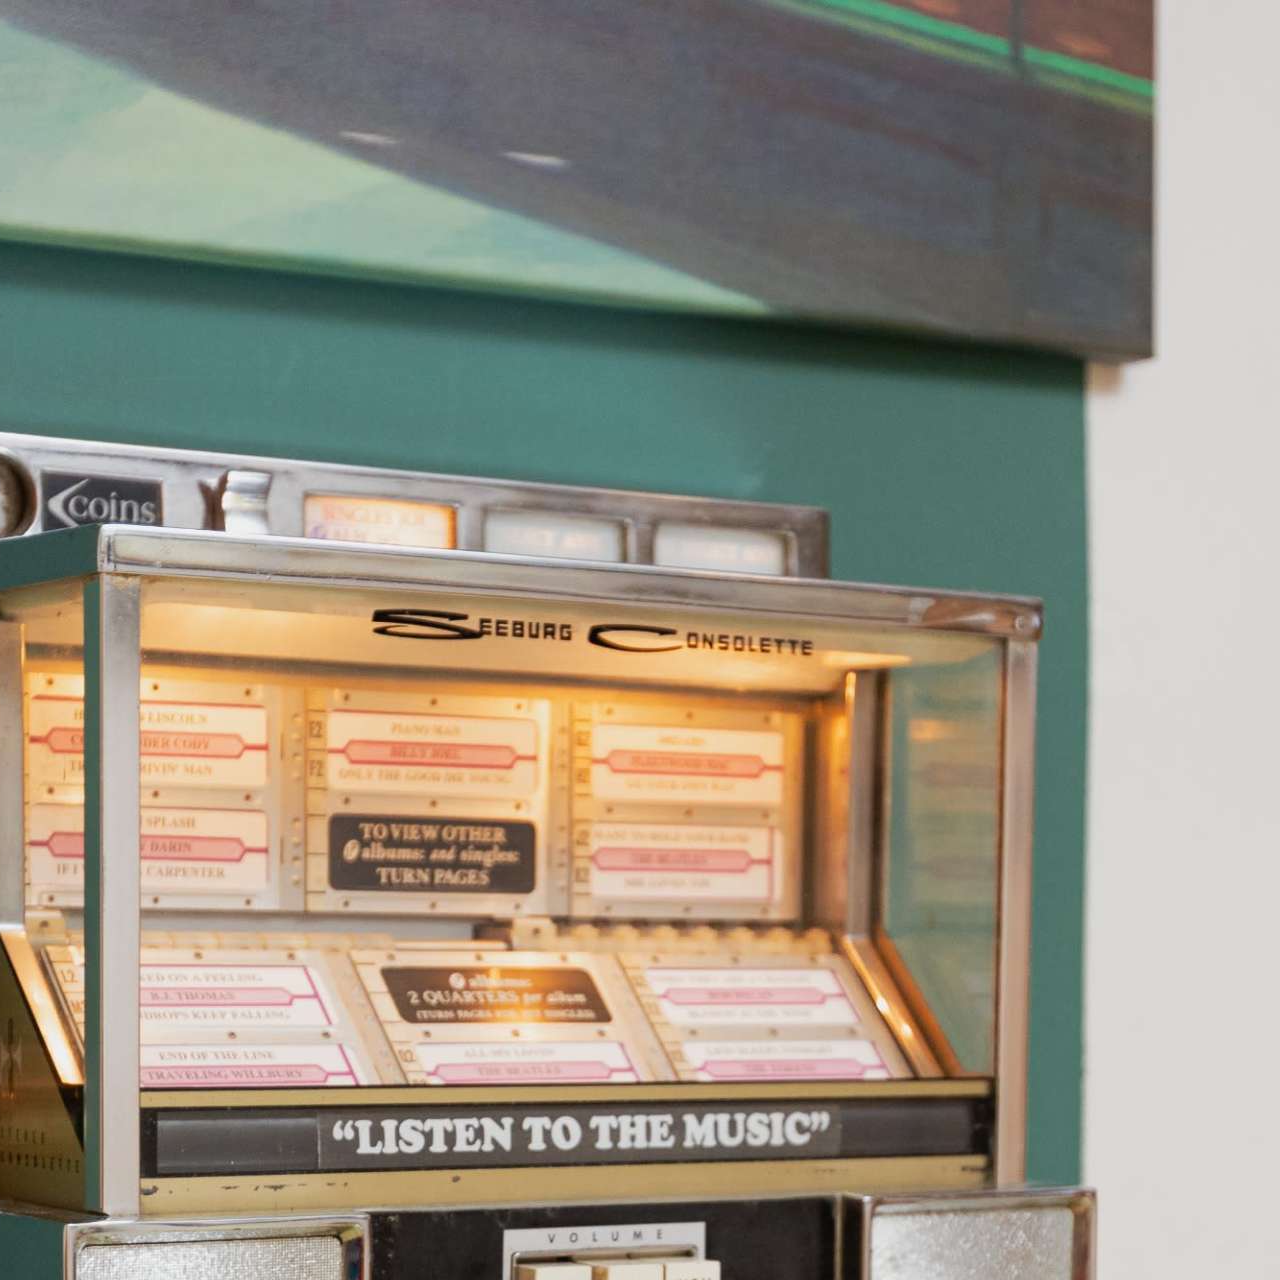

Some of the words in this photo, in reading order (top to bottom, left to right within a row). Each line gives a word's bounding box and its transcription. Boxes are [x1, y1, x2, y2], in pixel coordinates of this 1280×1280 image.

[69, 489, 156, 526] coins
[372, 607, 573, 641] SEEBURG
[587, 623, 814, 657] CONSOLETTE
[359, 822, 389, 840] TO
[390, 823, 439, 841] VIEW
[441, 826, 507, 844] OTHER
[376, 866, 430, 885] TURN
[433, 868, 490, 886] PAGES
[332, 1115, 513, 1156] “LISTEN
[523, 1115, 583, 1150] TO
[590, 1113, 676, 1149] THE
[683, 1111, 831, 1148] MUSIC”
[547, 1228, 665, 1244] VOLUME
